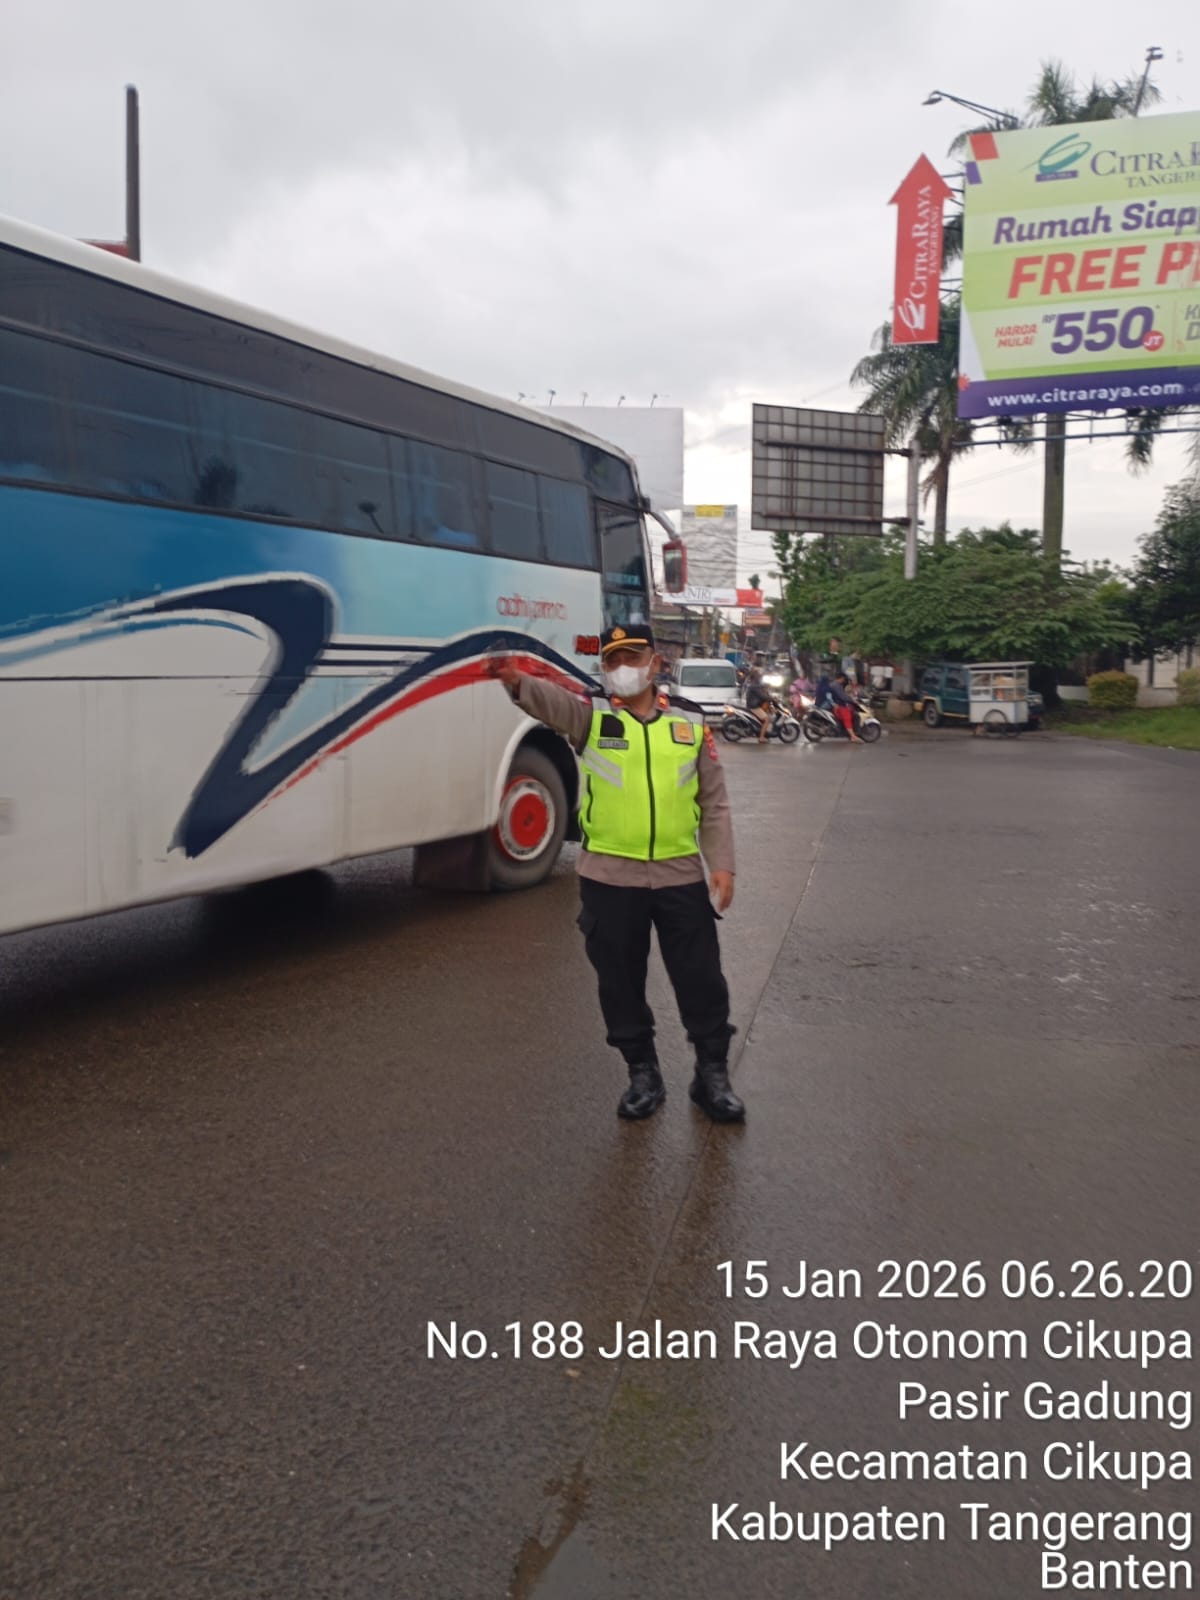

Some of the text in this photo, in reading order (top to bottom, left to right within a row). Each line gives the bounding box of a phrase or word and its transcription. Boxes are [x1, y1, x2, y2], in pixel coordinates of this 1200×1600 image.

[993, 205, 1112, 244] Rumah
[1007, 245, 1147, 299] FREE
[995, 324, 1037, 337] HARGA
[1051, 306, 1154, 354] 550
[987, 383, 1184, 407] www.citraraya.com
